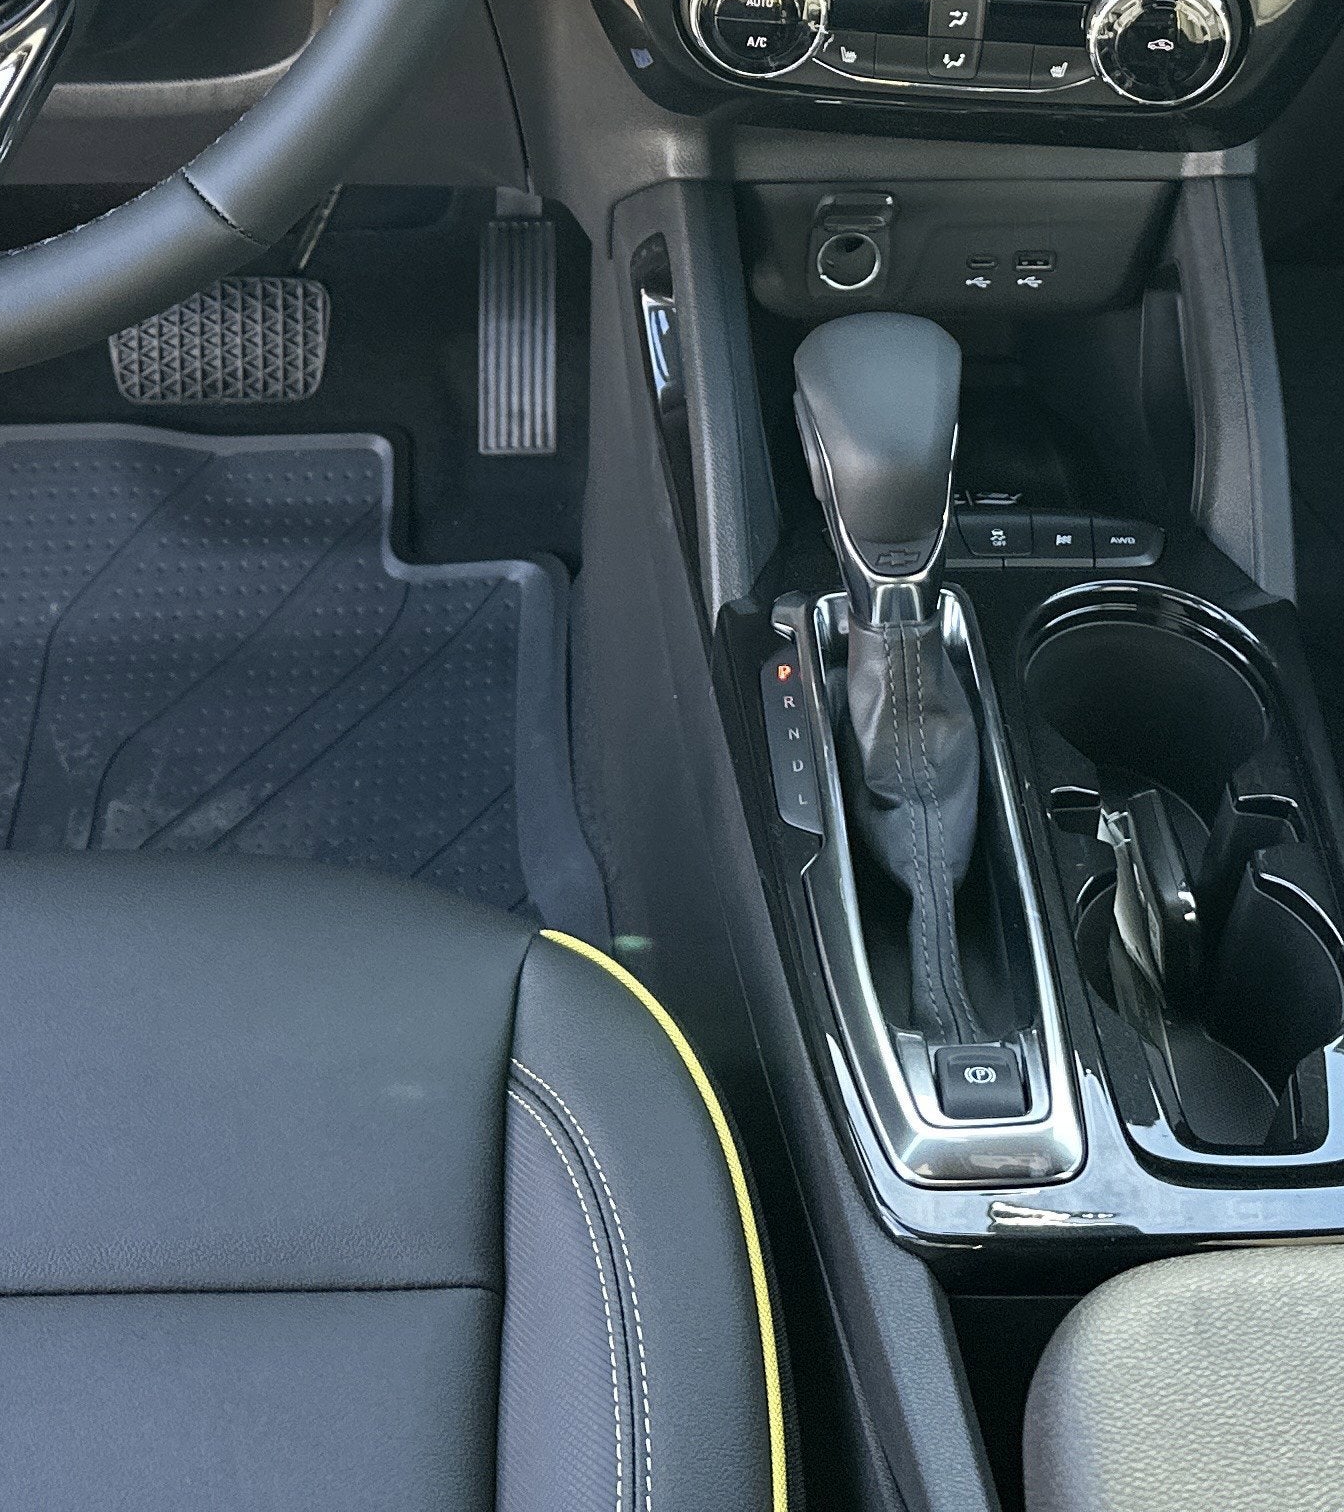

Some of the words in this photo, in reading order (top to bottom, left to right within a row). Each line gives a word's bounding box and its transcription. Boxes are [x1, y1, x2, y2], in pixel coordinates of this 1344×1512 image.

[746, 36, 768, 48] A/C
[1109, 535, 1136, 545] AWD
[777, 664, 792, 681] P
[783, 695, 796, 709] R
[788, 727, 800, 741] N
[792, 759, 804, 773] D
[798, 793, 808, 805] L
